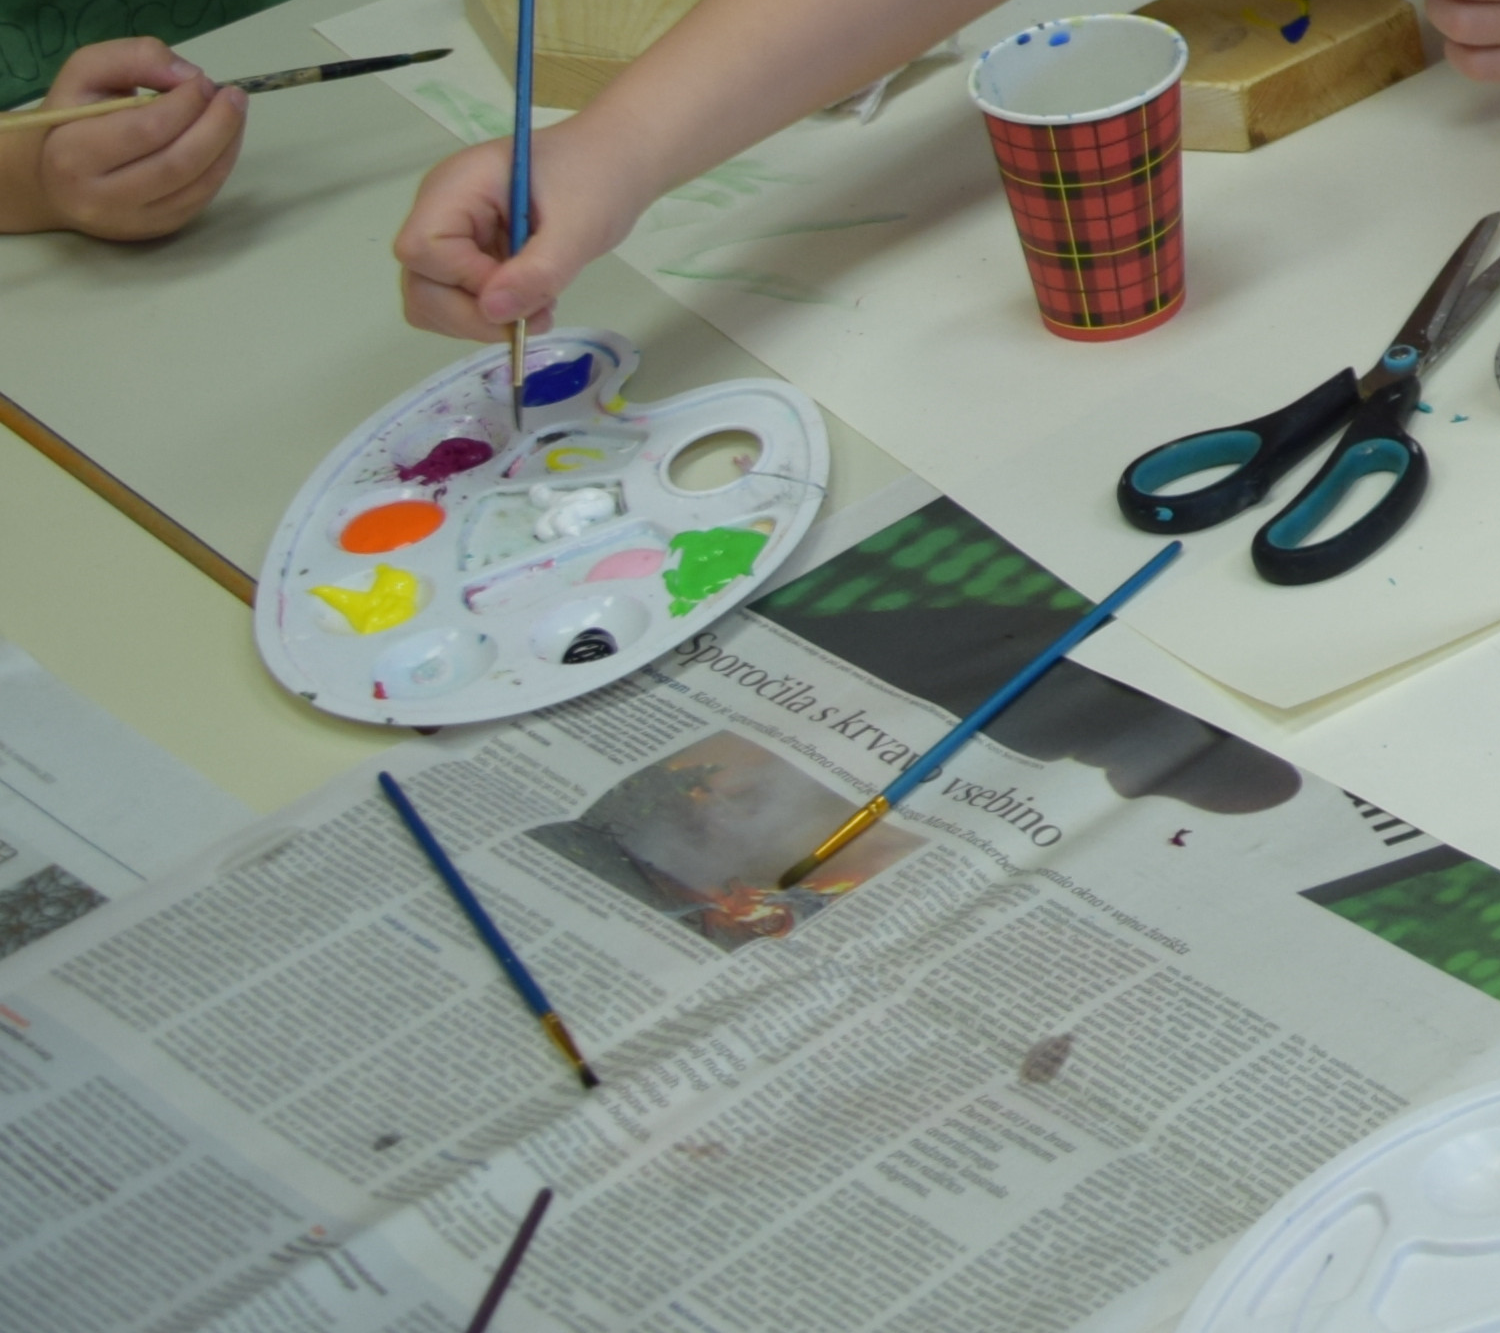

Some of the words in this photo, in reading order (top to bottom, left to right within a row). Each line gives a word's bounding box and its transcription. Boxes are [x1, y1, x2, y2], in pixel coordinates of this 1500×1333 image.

[674, 631, 816, 717] Sporočila
[808, 703, 840, 724] s
[939, 775, 1064, 850] vsebino
[957, 829, 1030, 878] Zuckerberg
[1071, 884, 1104, 909] okno
